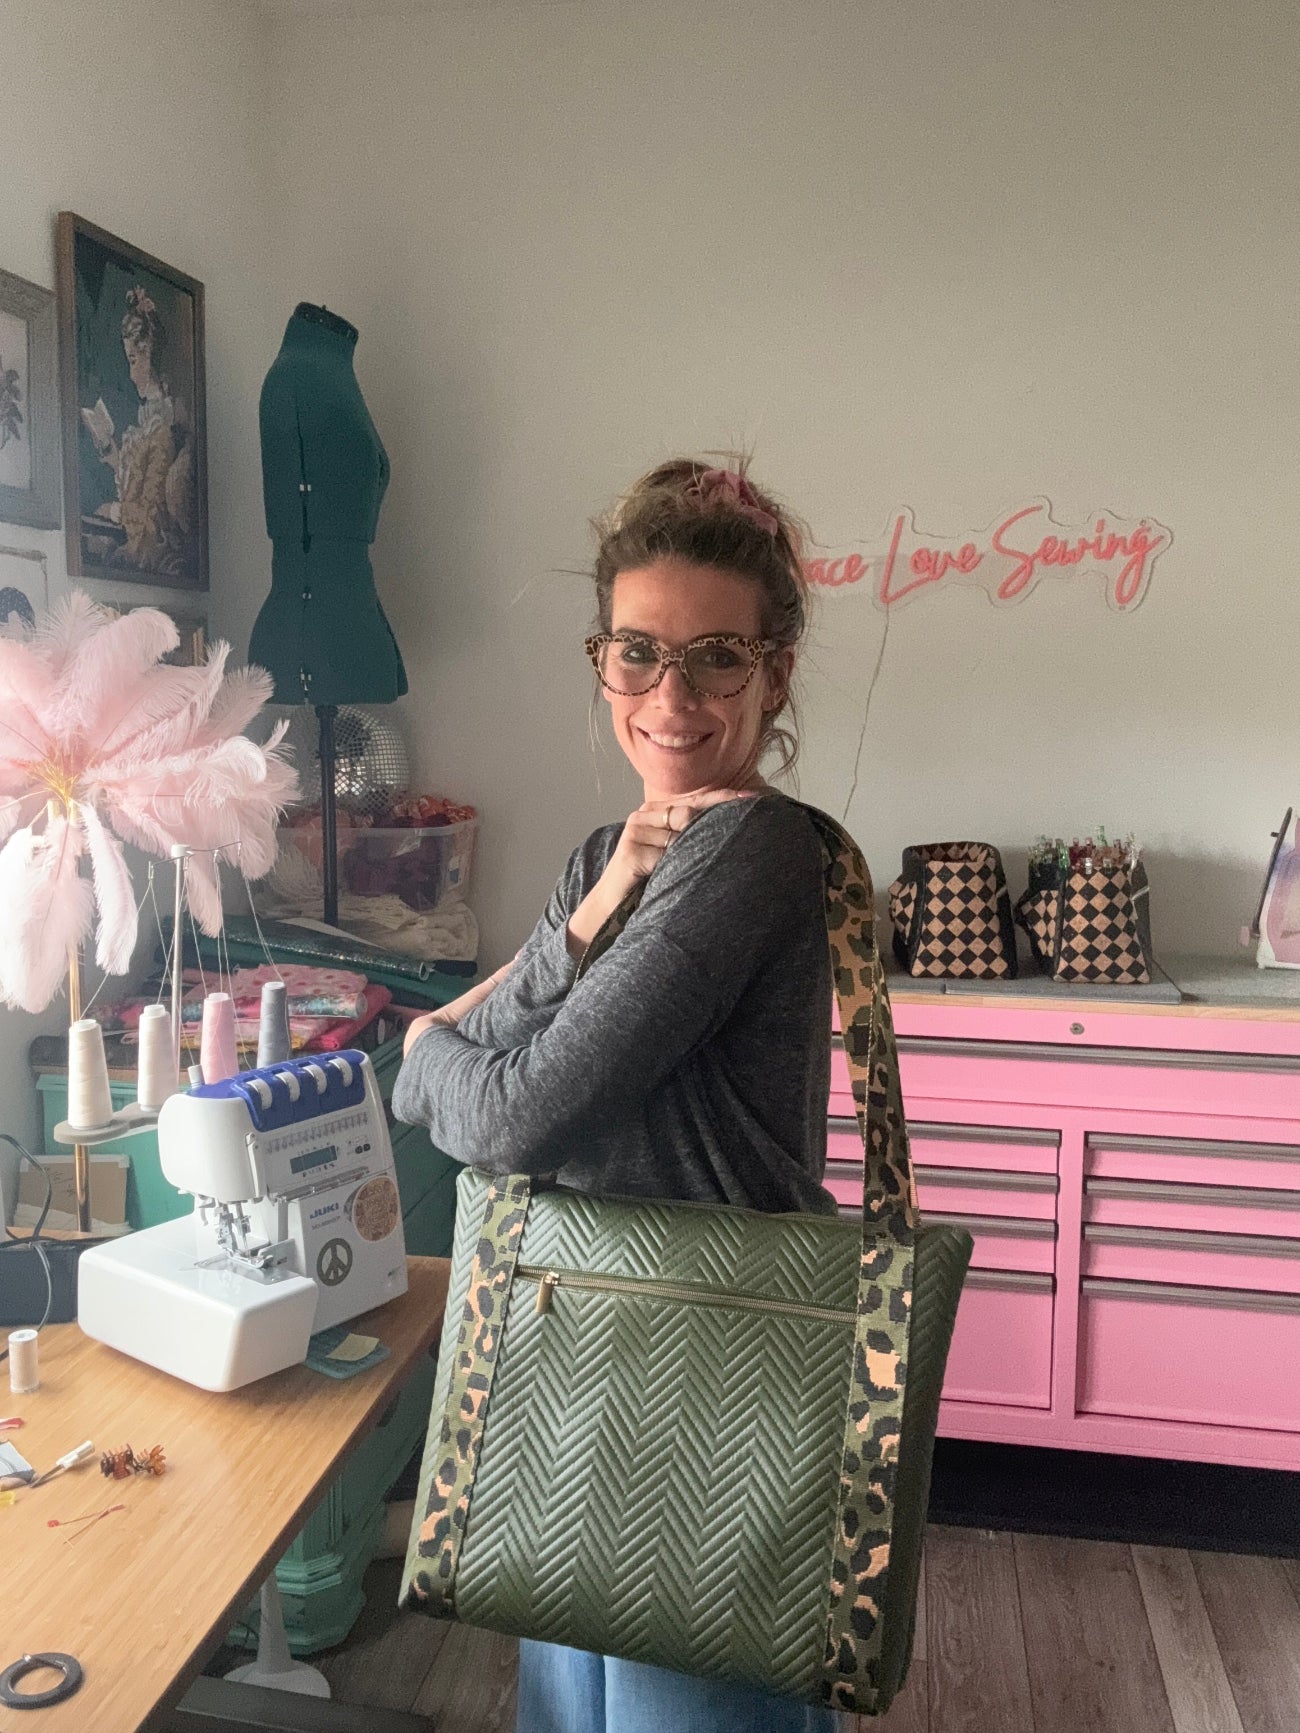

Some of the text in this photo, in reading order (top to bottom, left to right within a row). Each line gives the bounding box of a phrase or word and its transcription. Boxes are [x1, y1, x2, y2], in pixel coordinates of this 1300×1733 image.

[799, 505, 1163, 605] ace Love Sewing
[309, 1202, 339, 1219] JUKI
